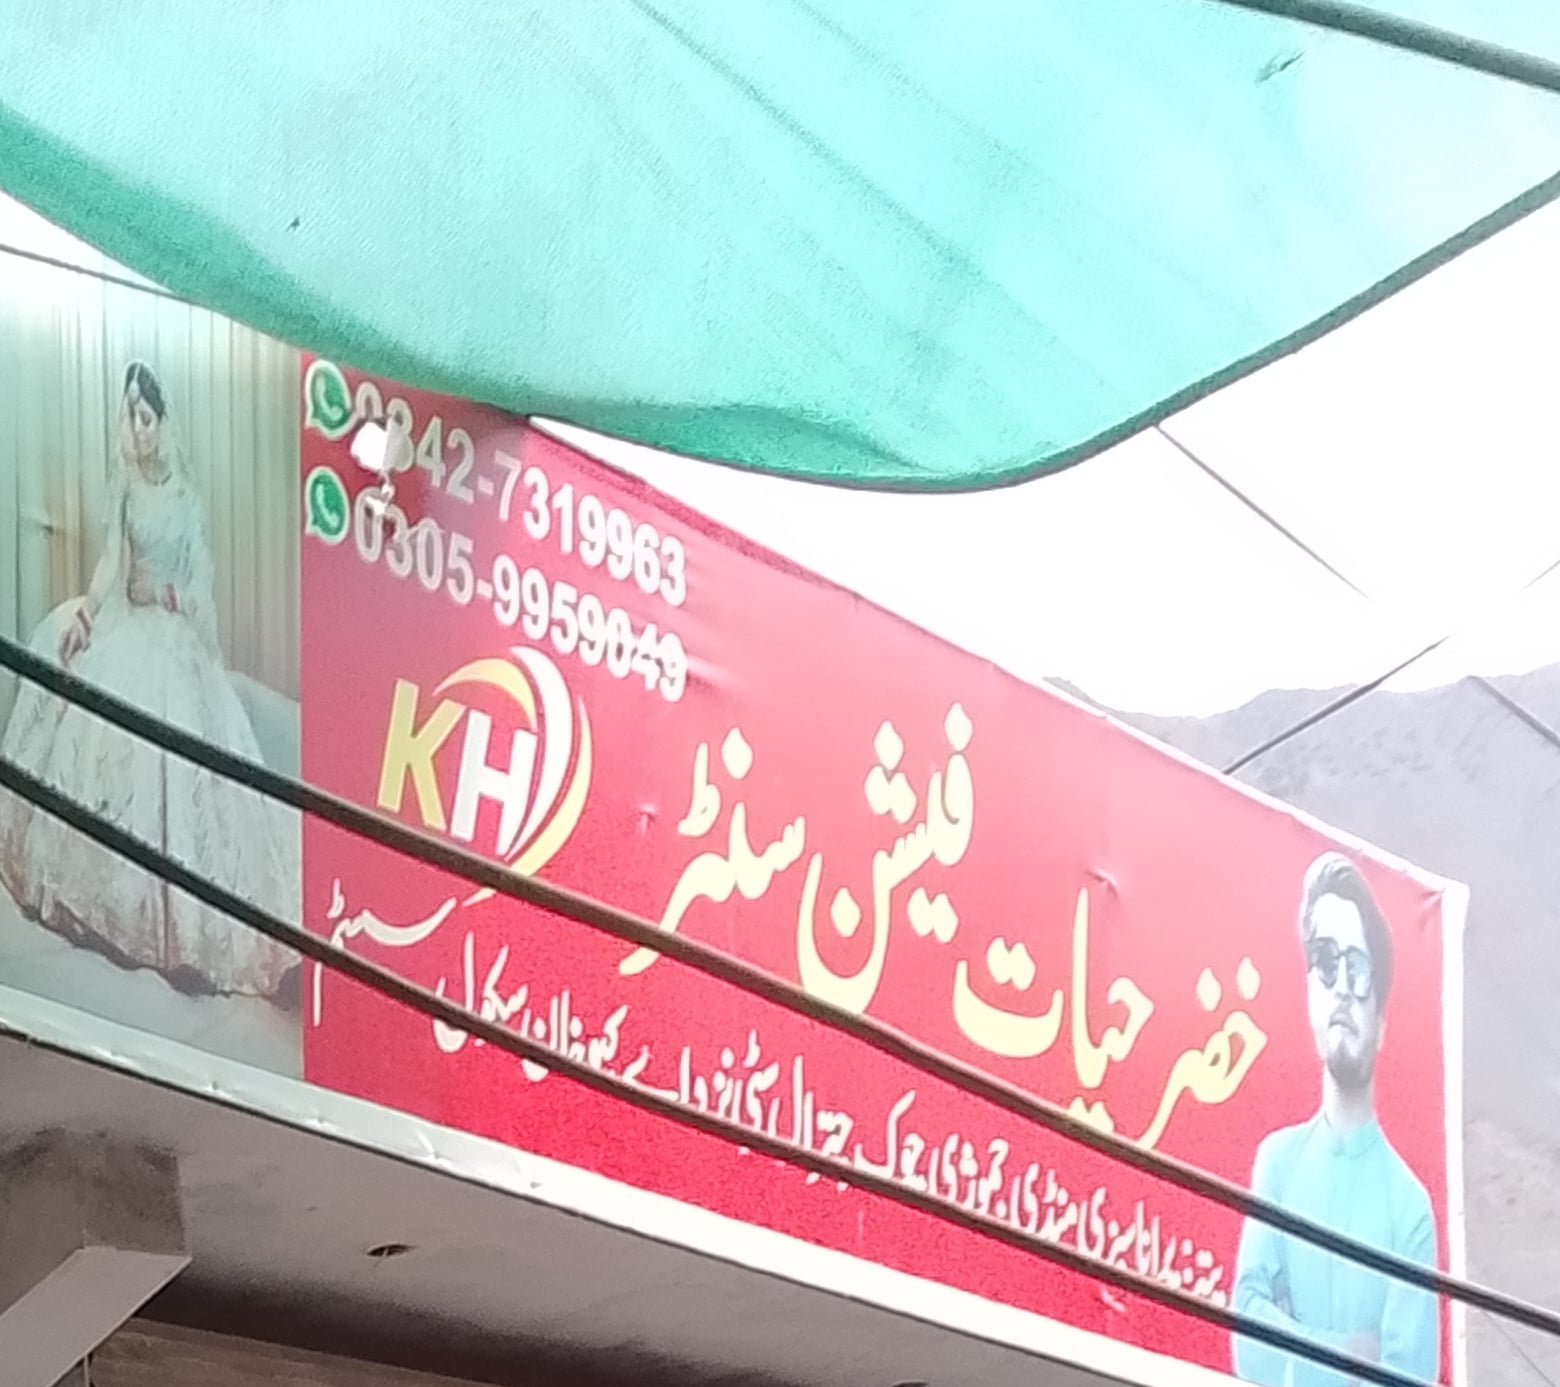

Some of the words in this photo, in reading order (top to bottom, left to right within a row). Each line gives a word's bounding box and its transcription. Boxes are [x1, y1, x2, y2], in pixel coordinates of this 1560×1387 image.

[376, 677, 539, 856] KH
[618, 726, 806, 976] سنٹر
[796, 702, 975, 1022] فیشن
[952, 887, 1155, 1136] حیات
[1137, 957, 1268, 1156] خضر
